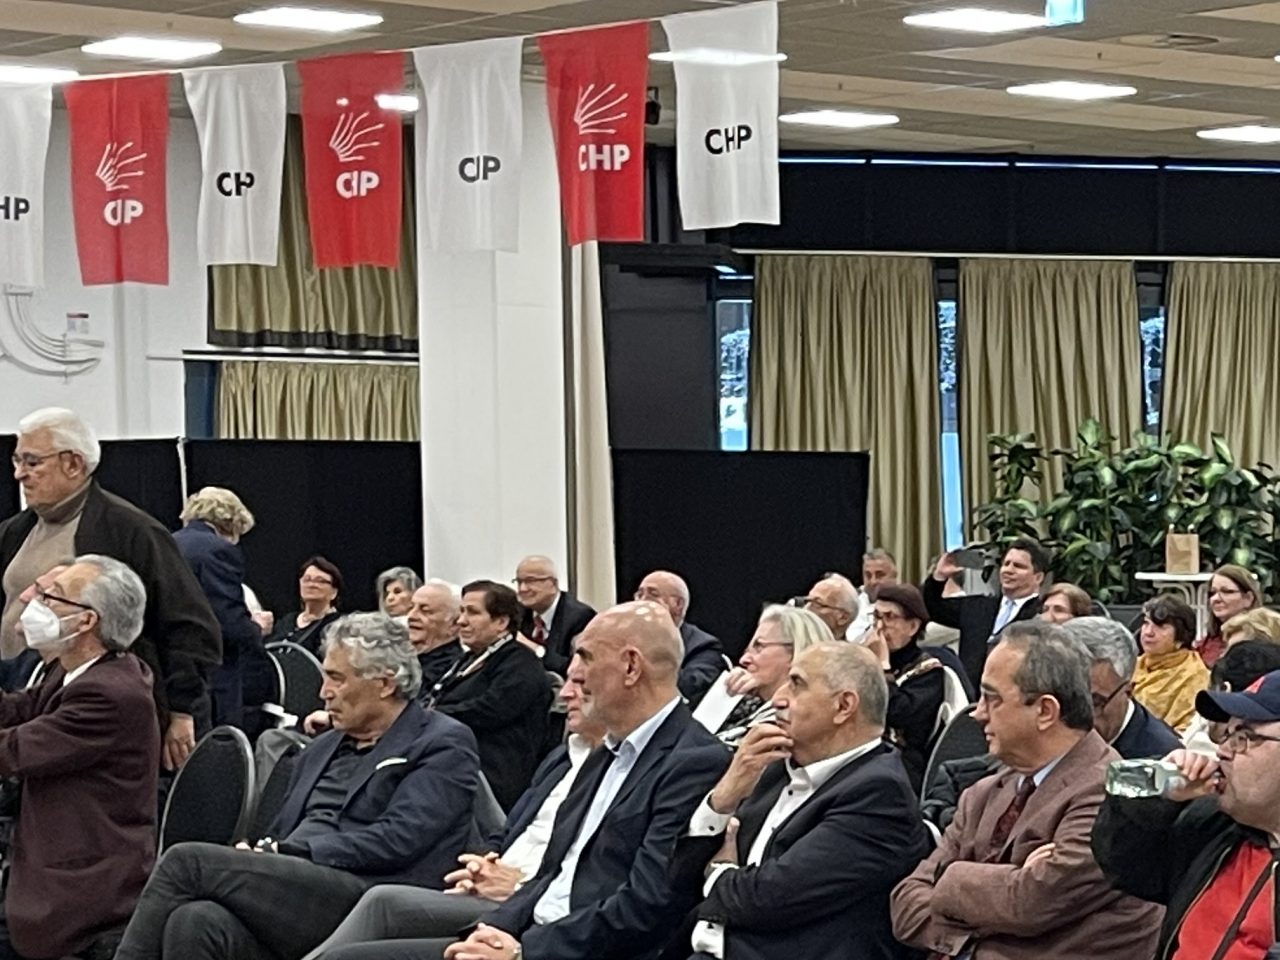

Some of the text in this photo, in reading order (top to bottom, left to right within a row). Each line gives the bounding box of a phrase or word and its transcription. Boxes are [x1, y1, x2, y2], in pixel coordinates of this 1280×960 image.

[704, 124, 753, 155] CHP
[578, 144, 631, 171] CHP
[0, 196, 30, 221] HP
